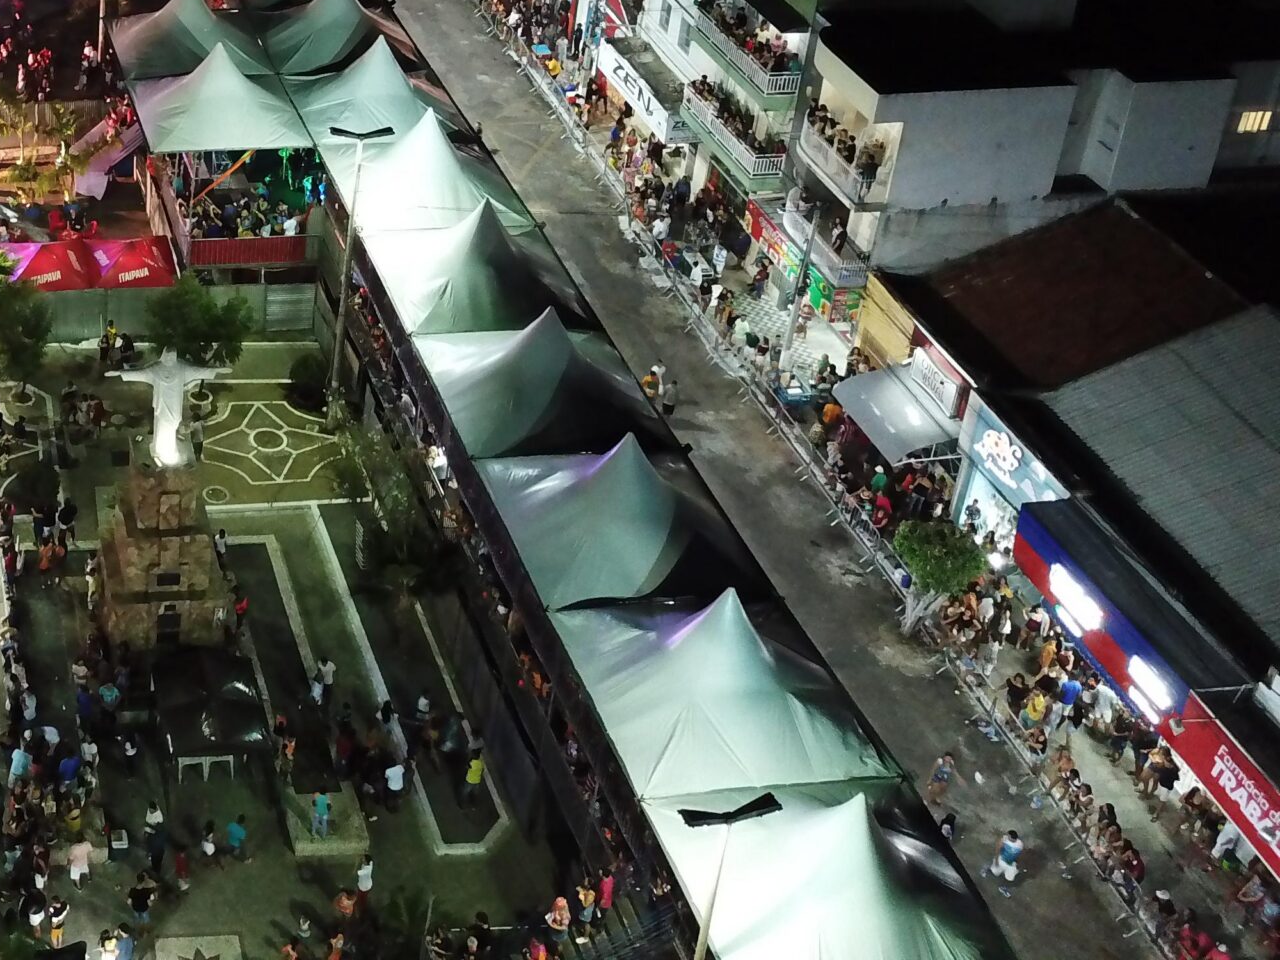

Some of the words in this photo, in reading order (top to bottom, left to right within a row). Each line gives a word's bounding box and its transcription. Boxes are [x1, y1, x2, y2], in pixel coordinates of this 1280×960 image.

[612, 58, 654, 117] ZEN
[673, 119, 690, 132] ZE
[118, 267, 150, 284] ITAIPAVA
